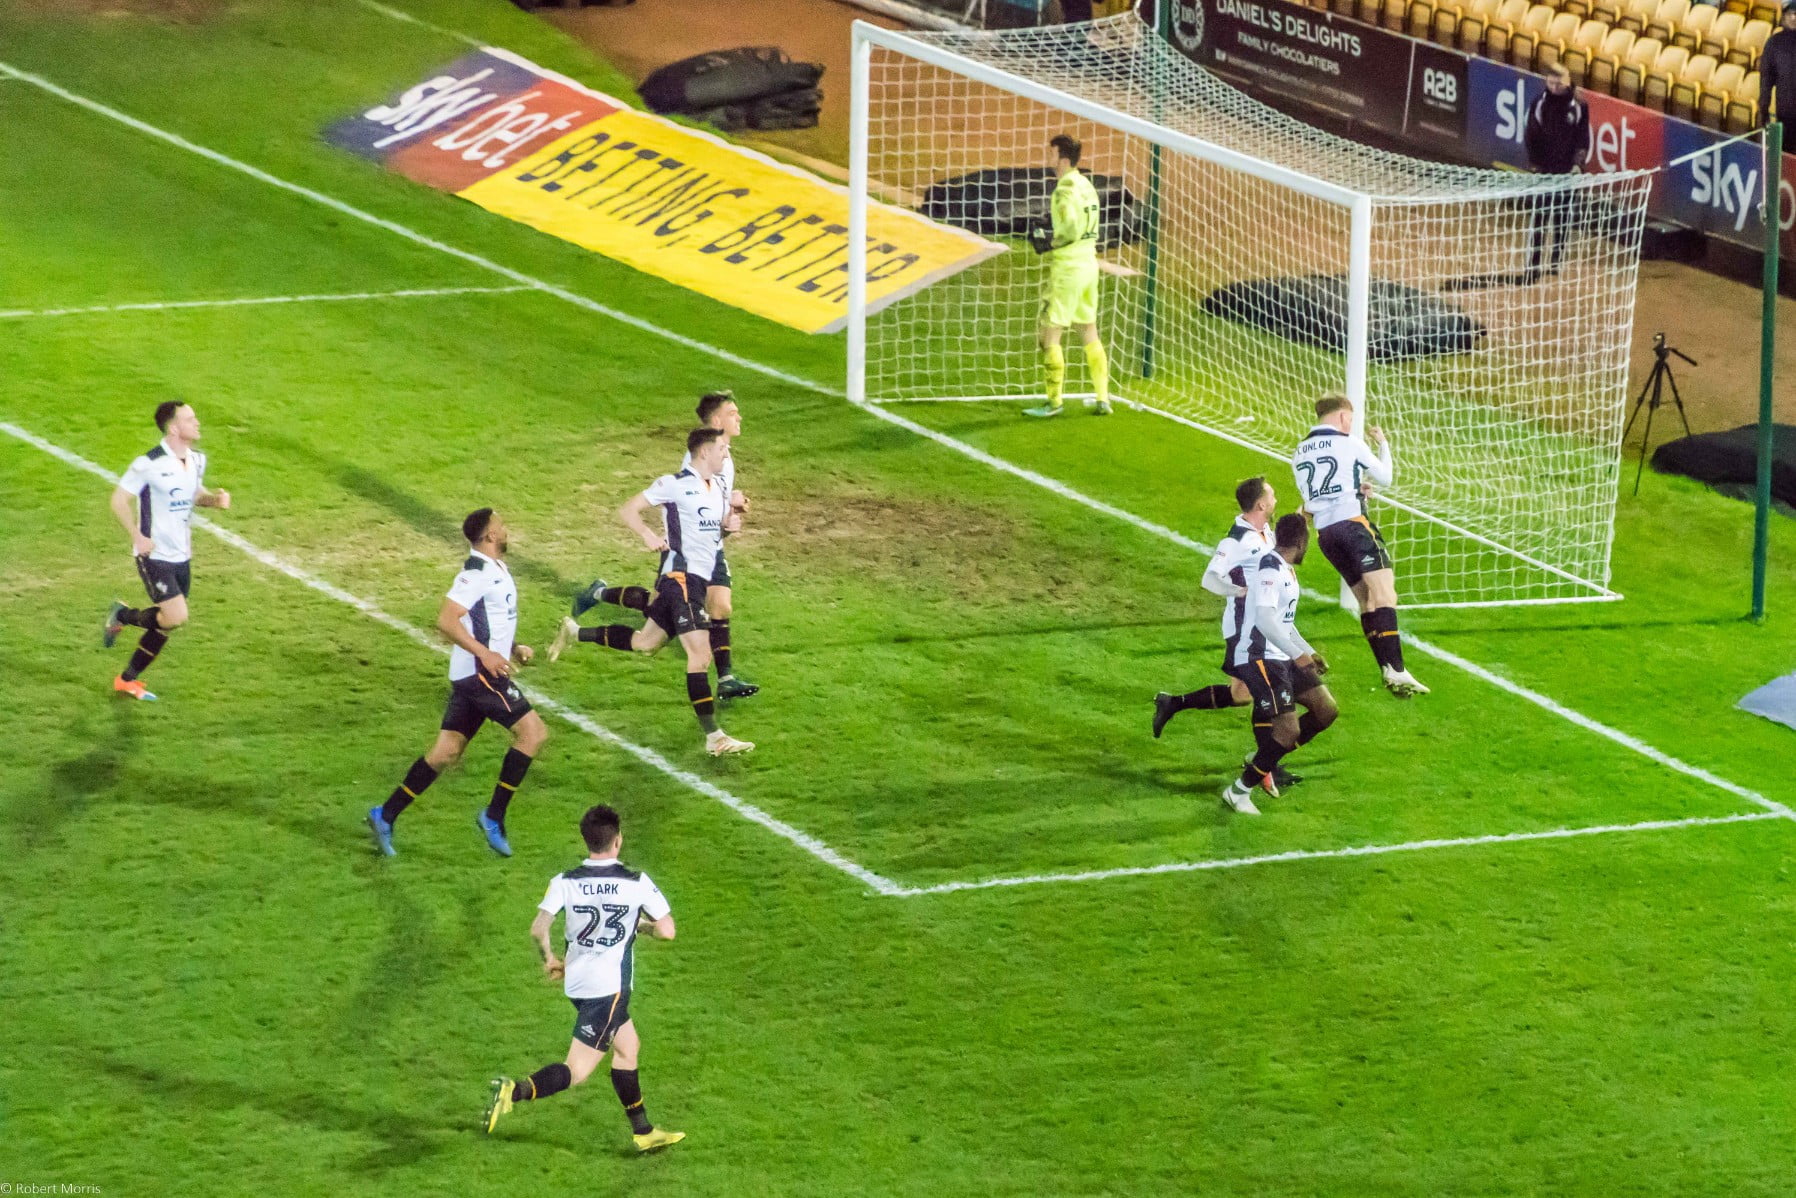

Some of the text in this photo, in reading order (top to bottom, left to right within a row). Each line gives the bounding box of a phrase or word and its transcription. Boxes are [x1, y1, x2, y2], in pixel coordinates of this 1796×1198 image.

[1216, 0, 1282, 32] DANIEL'S
[1285, 15, 1361, 57] DELIGHTS
[1238, 31, 1340, 75] FAMILY CHOCOLATIERS
[1423, 67, 1457, 102] A2B
[363, 68, 582, 168] sky bet
[1690, 142, 1757, 232] sky
[516, 131, 920, 303] BETTING, BETTER
[1296, 456, 1342, 501] 22
[582, 883, 619, 895] CLARK
[572, 903, 630, 948] 23
